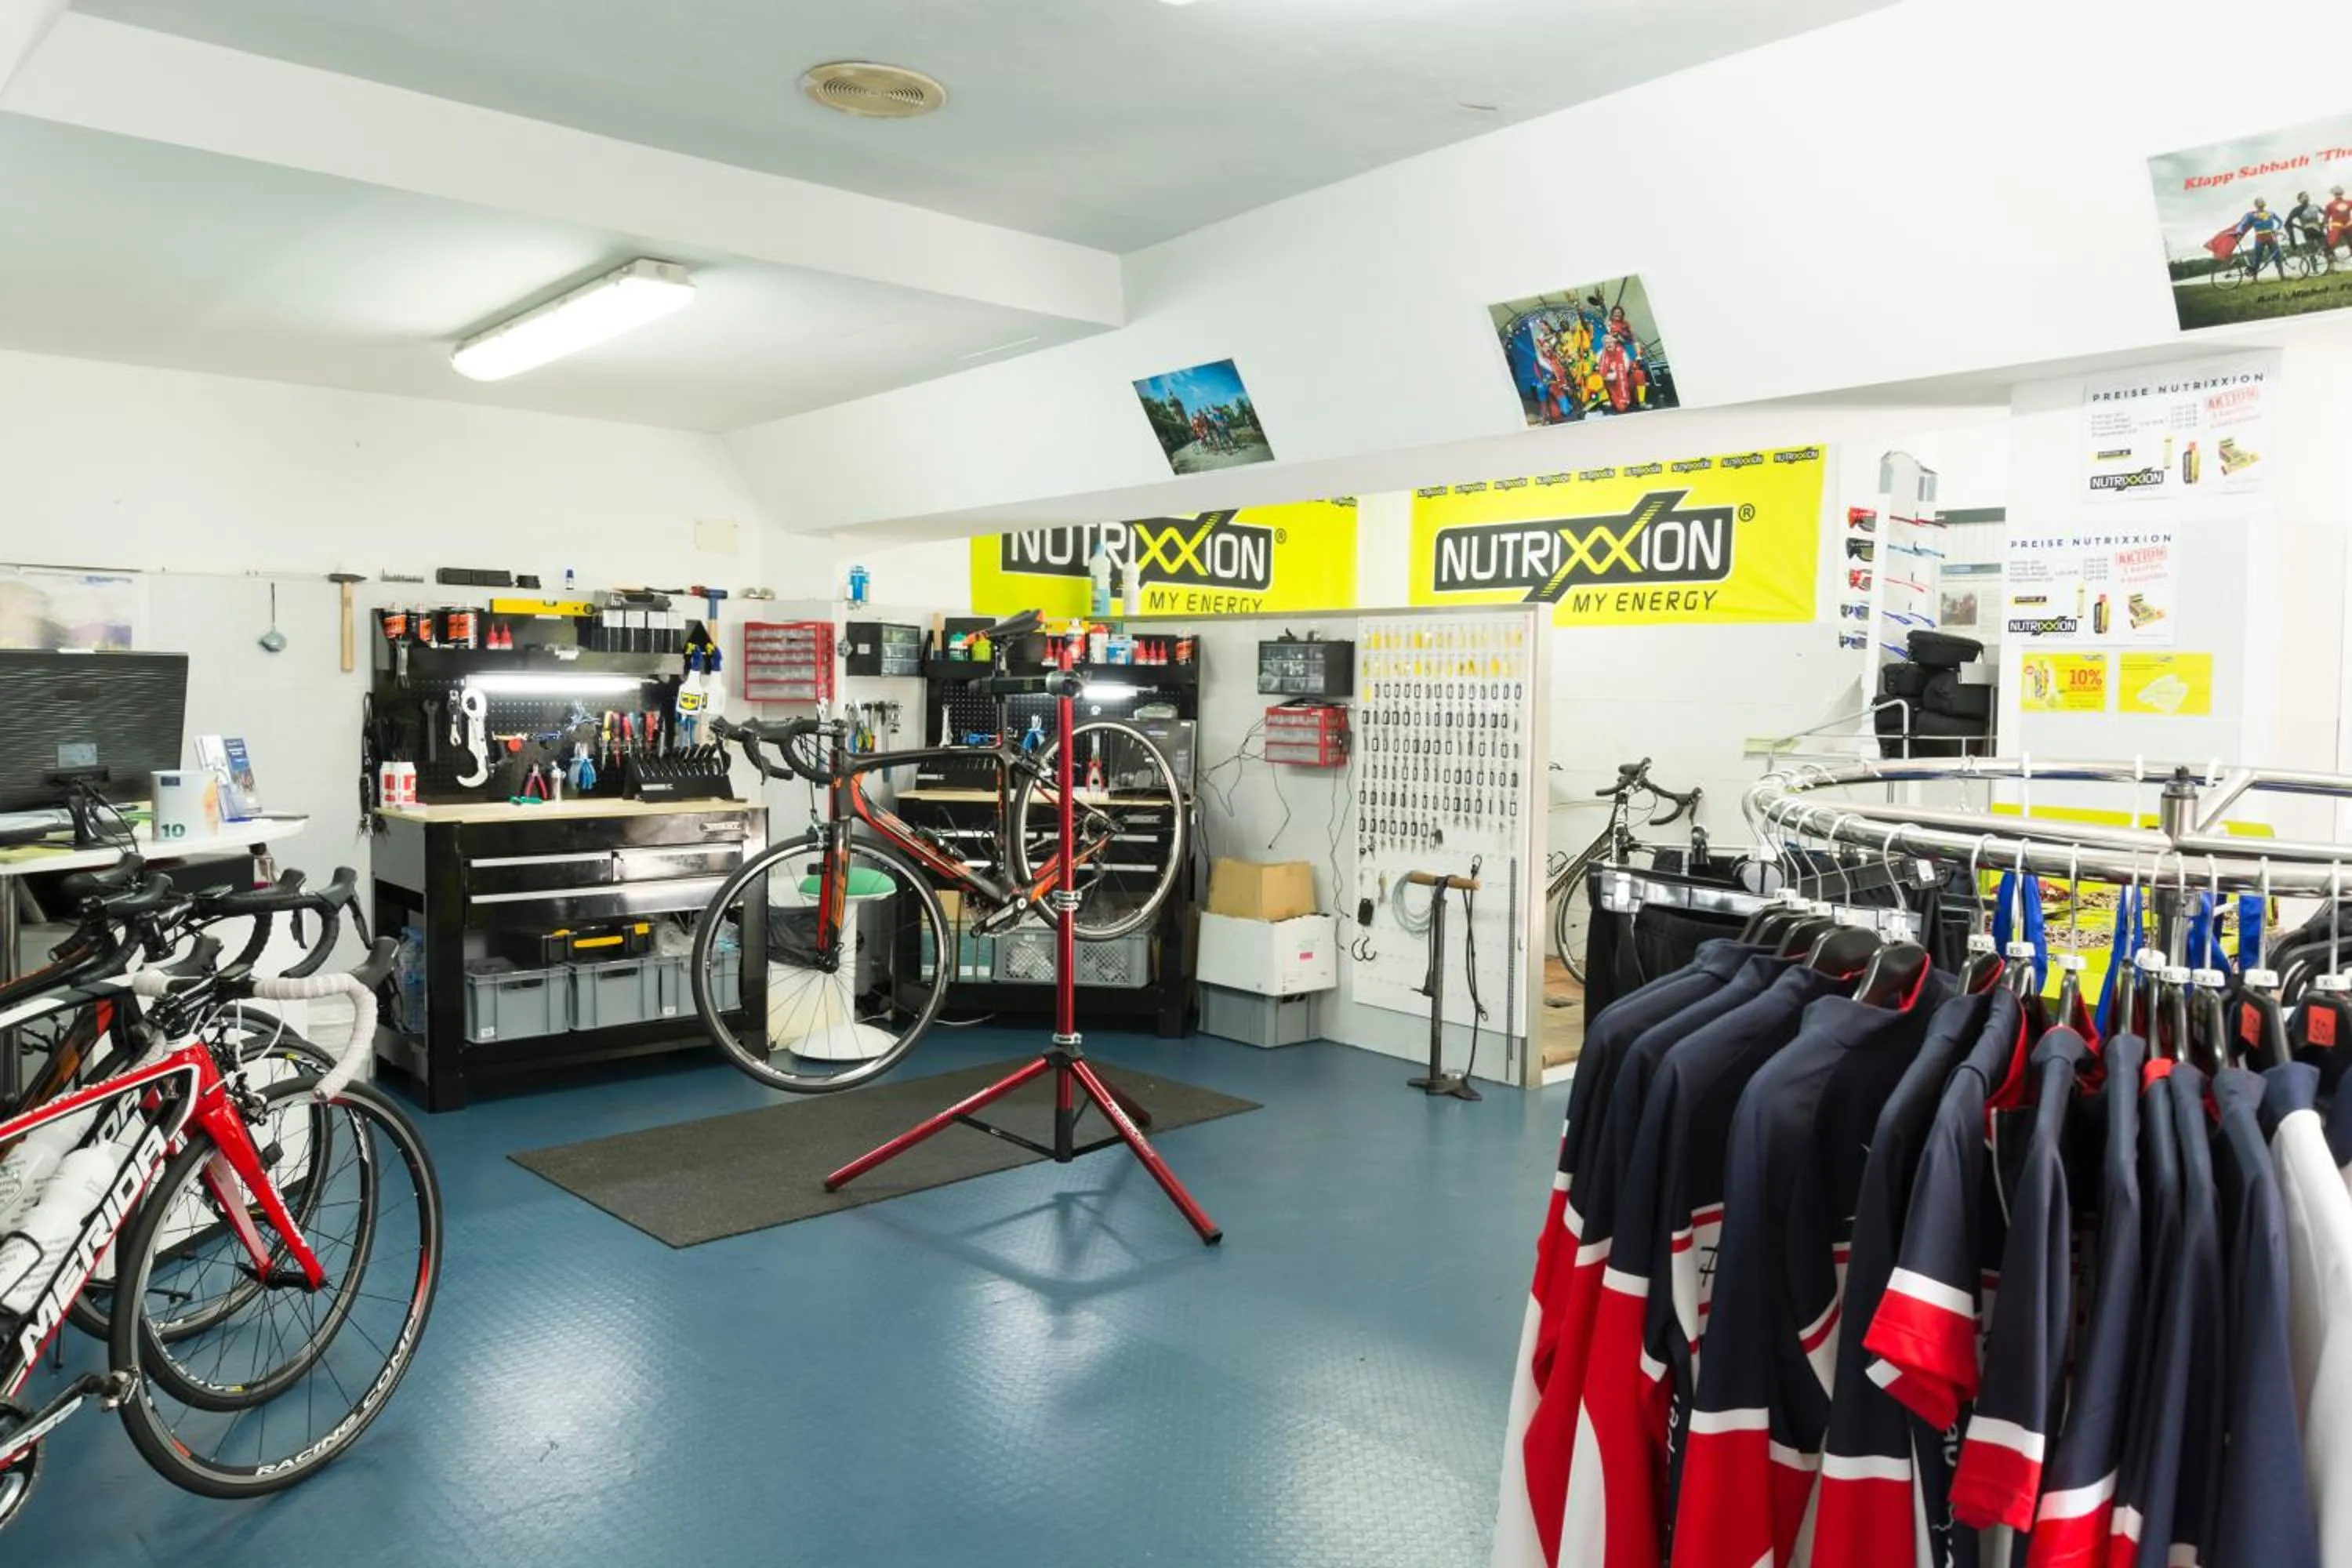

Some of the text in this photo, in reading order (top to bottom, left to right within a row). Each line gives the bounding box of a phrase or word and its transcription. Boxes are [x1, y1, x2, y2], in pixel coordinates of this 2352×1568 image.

[2183, 172, 2234, 191] Klapp
[2238, 154, 2310, 179] Sabbath
[2092, 372, 2265, 402] PREISE NUTRIXXION
[2091, 470, 2163, 489] NUTRIXXION
[1009, 517, 1266, 582] NUTRIXXION
[1441, 511, 1723, 589] NUTRIXXION
[2010, 534, 2172, 548] PREISE NUTRIXXION
[1149, 591, 1264, 615] MY ENERGY
[1573, 590, 1718, 613] MY ENERGY
[2009, 618, 2077, 633] NUTRIXXION
[2069, 669, 2103, 686] 10%
[162, 823, 186, 838] 10
[20, 1124, 167, 1366] MERIDA
[255, 1316, 417, 1476] RACING COMP
